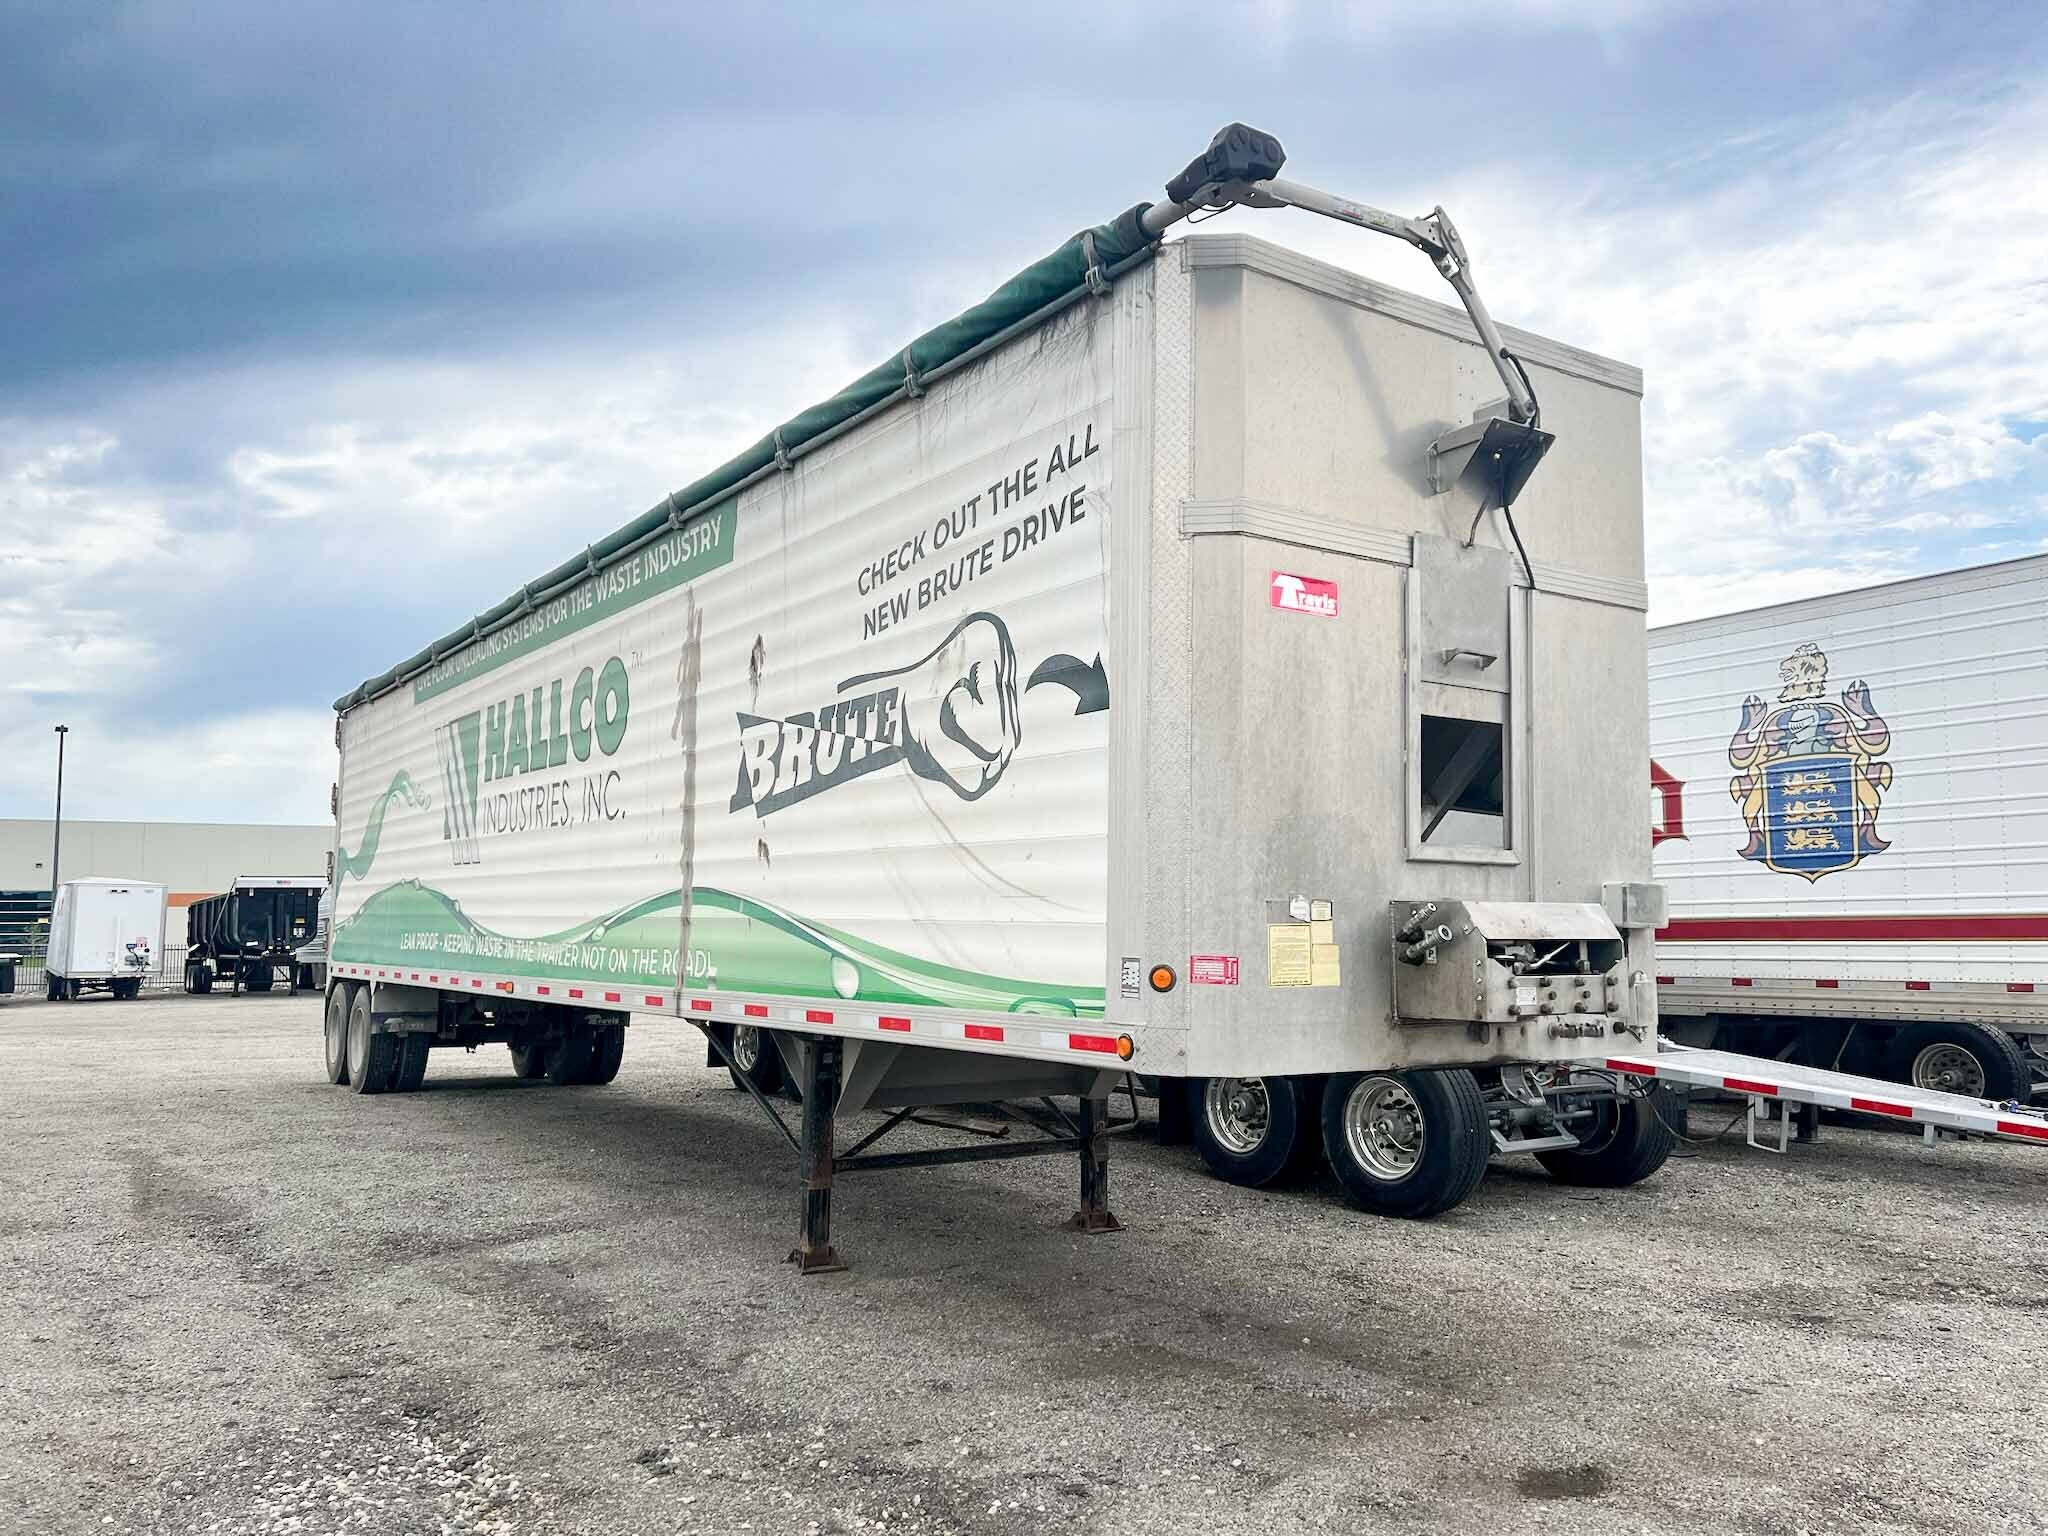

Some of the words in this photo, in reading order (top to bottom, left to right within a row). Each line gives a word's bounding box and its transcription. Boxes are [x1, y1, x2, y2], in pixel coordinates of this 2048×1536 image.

[858, 530, 926, 597] CHECK
[933, 494, 982, 551] OUT
[988, 457, 1039, 516] THE
[1046, 423, 1100, 483] ALL
[863, 588, 911, 640] NEW
[918, 539, 995, 612] BRUTE
[1001, 485, 1088, 562] DRIVE
[503, 612, 544, 649] SYSTEMS
[546, 599, 568, 629] FOR
[569, 583, 592, 617] THE
[595, 556, 641, 603] WASTE
[644, 514, 722, 581] INDUSTRY
[484, 656, 630, 783] HALLCO
[730, 687, 900, 816] BRUTE
[483, 779, 574, 834] INDUSTRIES,
[581, 770, 627, 823] INC.
[400, 932, 415, 951] LEAK
[416, 933, 438, 951] PROOF
[443, 933, 474, 955] KEEPING
[475, 935, 502, 958] WASTE
[503, 938, 513, 960] IN
[514, 938, 534, 962] THE
[535, 941, 578, 967] TRAILER
[581, 945, 607, 970] NOT
[609, 948, 628, 973] ON
[631, 948, 658, 975] THE
